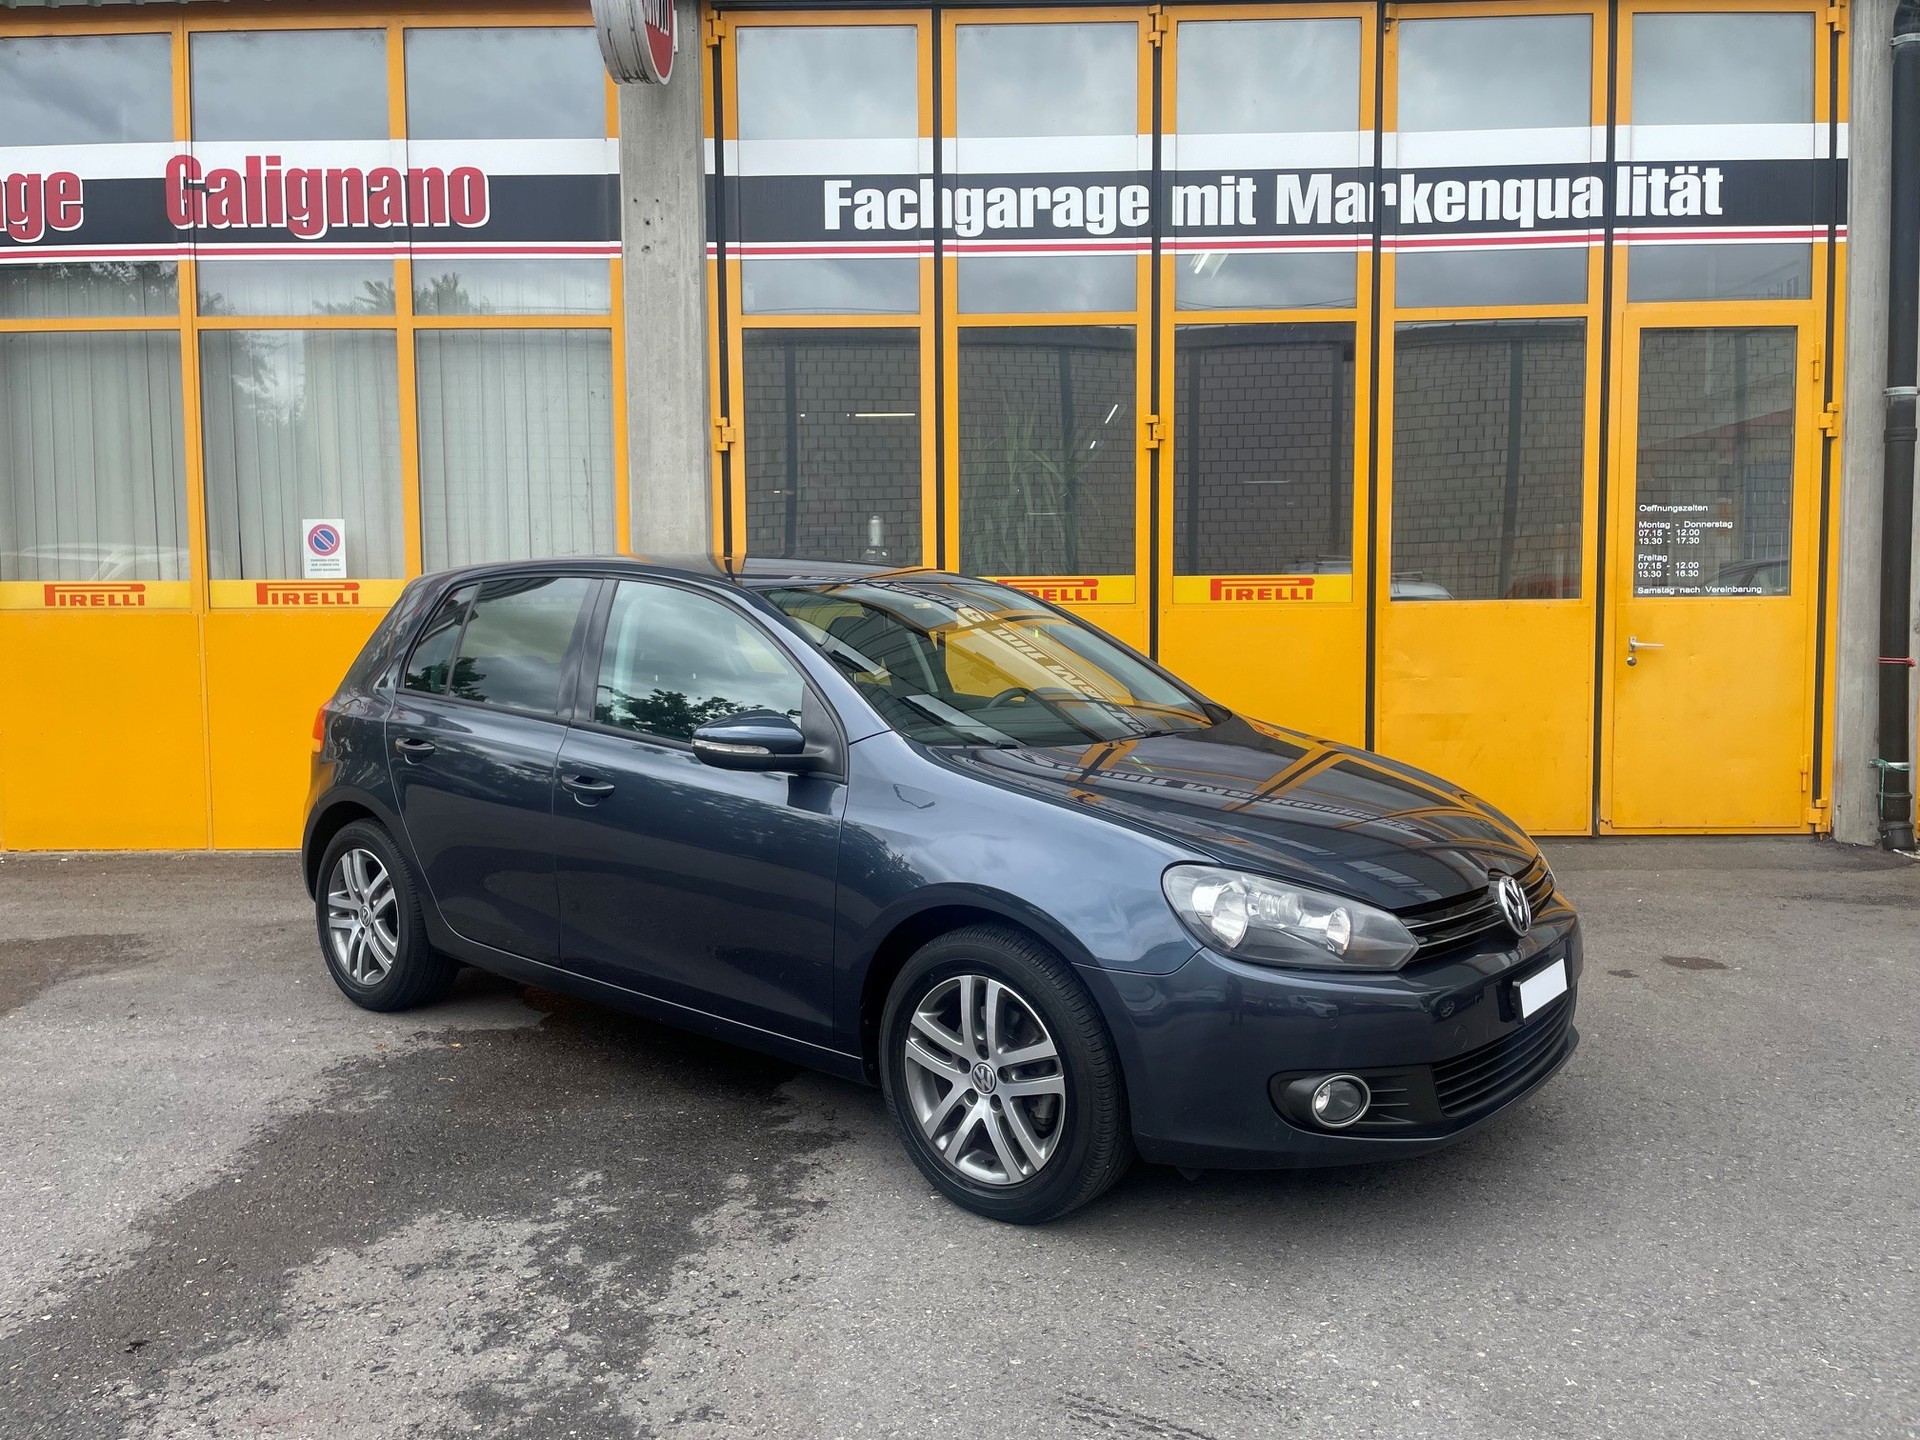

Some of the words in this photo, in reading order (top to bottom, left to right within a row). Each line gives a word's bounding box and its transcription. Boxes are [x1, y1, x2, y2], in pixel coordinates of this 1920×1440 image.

[165, 154, 490, 239] Galignano
[823, 178, 1150, 237] Fachgarage
[1172, 175, 1257, 227] mit
[1639, 504, 1708, 512] Oeffnungszeiten
[1638, 521, 1670, 529] Montag
[1684, 520, 1733, 528] Donnerstag
[1638, 529, 1663, 537] 07.15
[1638, 537, 1662, 545] 13.30
[1638, 554, 1668, 562] Freitag
[1638, 562, 1662, 570] 07.15
[1638, 570, 1662, 578] 13.30
[1210, 577, 1315, 600] PIRELLI
[1637, 587, 1674, 595] Samstag
[1705, 586, 1762, 594] Vereinbarung
[44, 583, 146, 607] PIRELLI
[256, 582, 360, 605] PIRELLI
